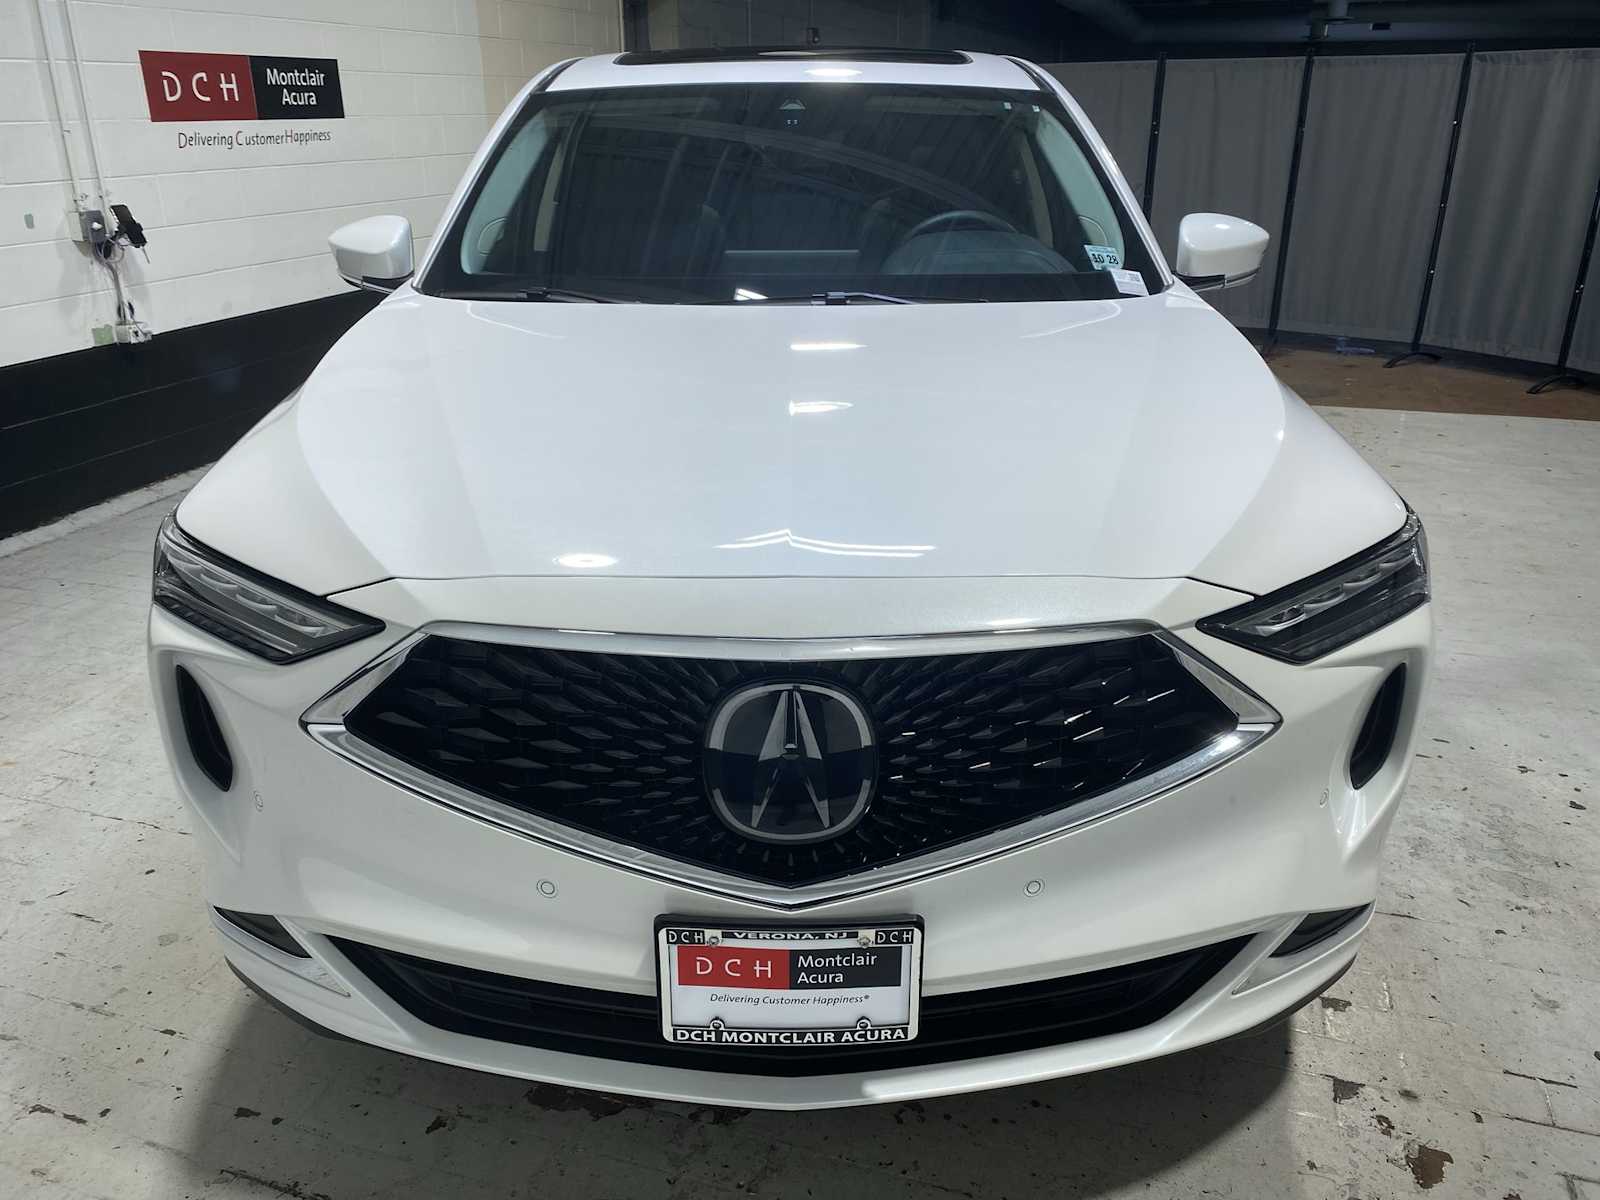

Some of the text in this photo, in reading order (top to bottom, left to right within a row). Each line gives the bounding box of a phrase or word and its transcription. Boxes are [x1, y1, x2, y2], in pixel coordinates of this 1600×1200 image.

[266, 68, 325, 86] Montclair
[161, 71, 239, 102] DCH
[282, 89, 317, 105] Acura
[178, 129, 331, 149] Delivering Customer Happiness
[668, 931, 704, 943] DCH
[733, 931, 848, 940] VERONA, NJ
[877, 931, 912, 943] DCH
[695, 956, 772, 979] DCH
[797, 953, 878, 969] Montclair
[797, 972, 844, 984] Acura
[710, 993, 760, 1006] Delivering
[762, 995, 811, 1005] Customer
[676, 1029, 906, 1044] DCH MONTCLAIR ACURA
